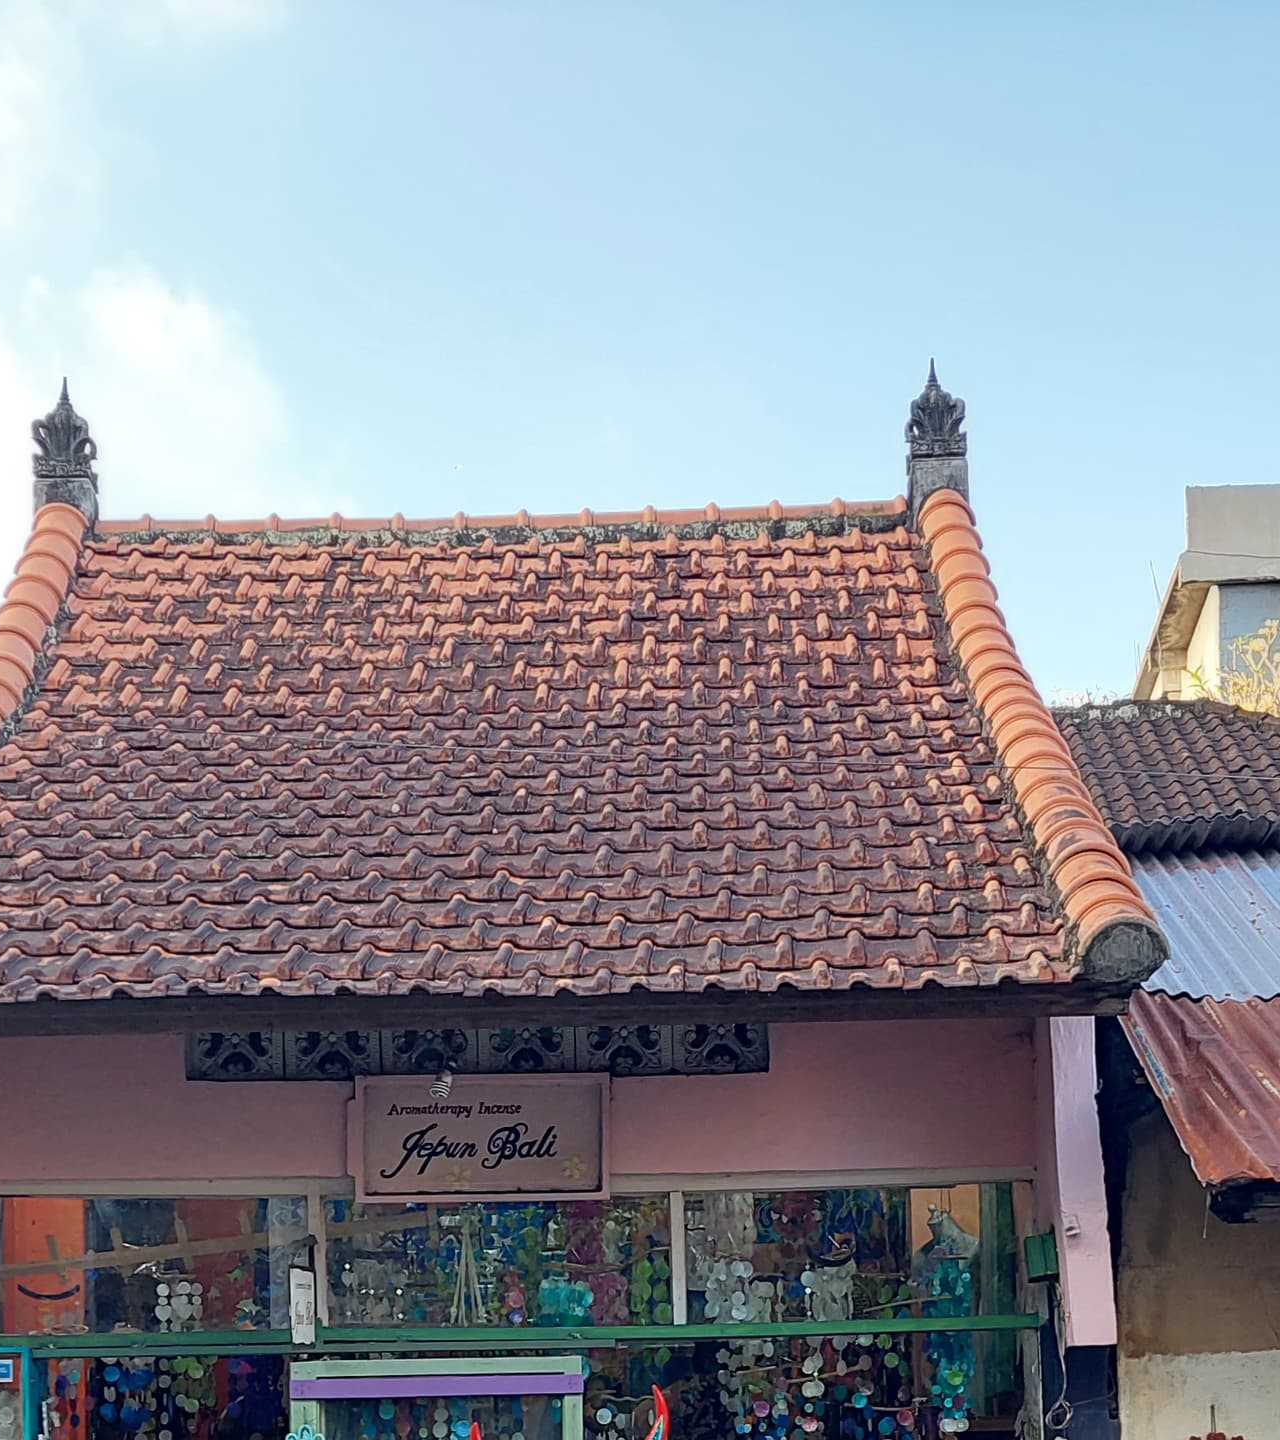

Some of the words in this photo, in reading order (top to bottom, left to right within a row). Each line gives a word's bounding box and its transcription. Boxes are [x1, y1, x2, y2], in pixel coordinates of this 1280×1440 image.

[386, 1102, 473, 1118] Aromatherapy
[477, 1101, 522, 1116] Incense
[379, 1122, 479, 1179] Jepun
[481, 1121, 558, 1170] Bali
